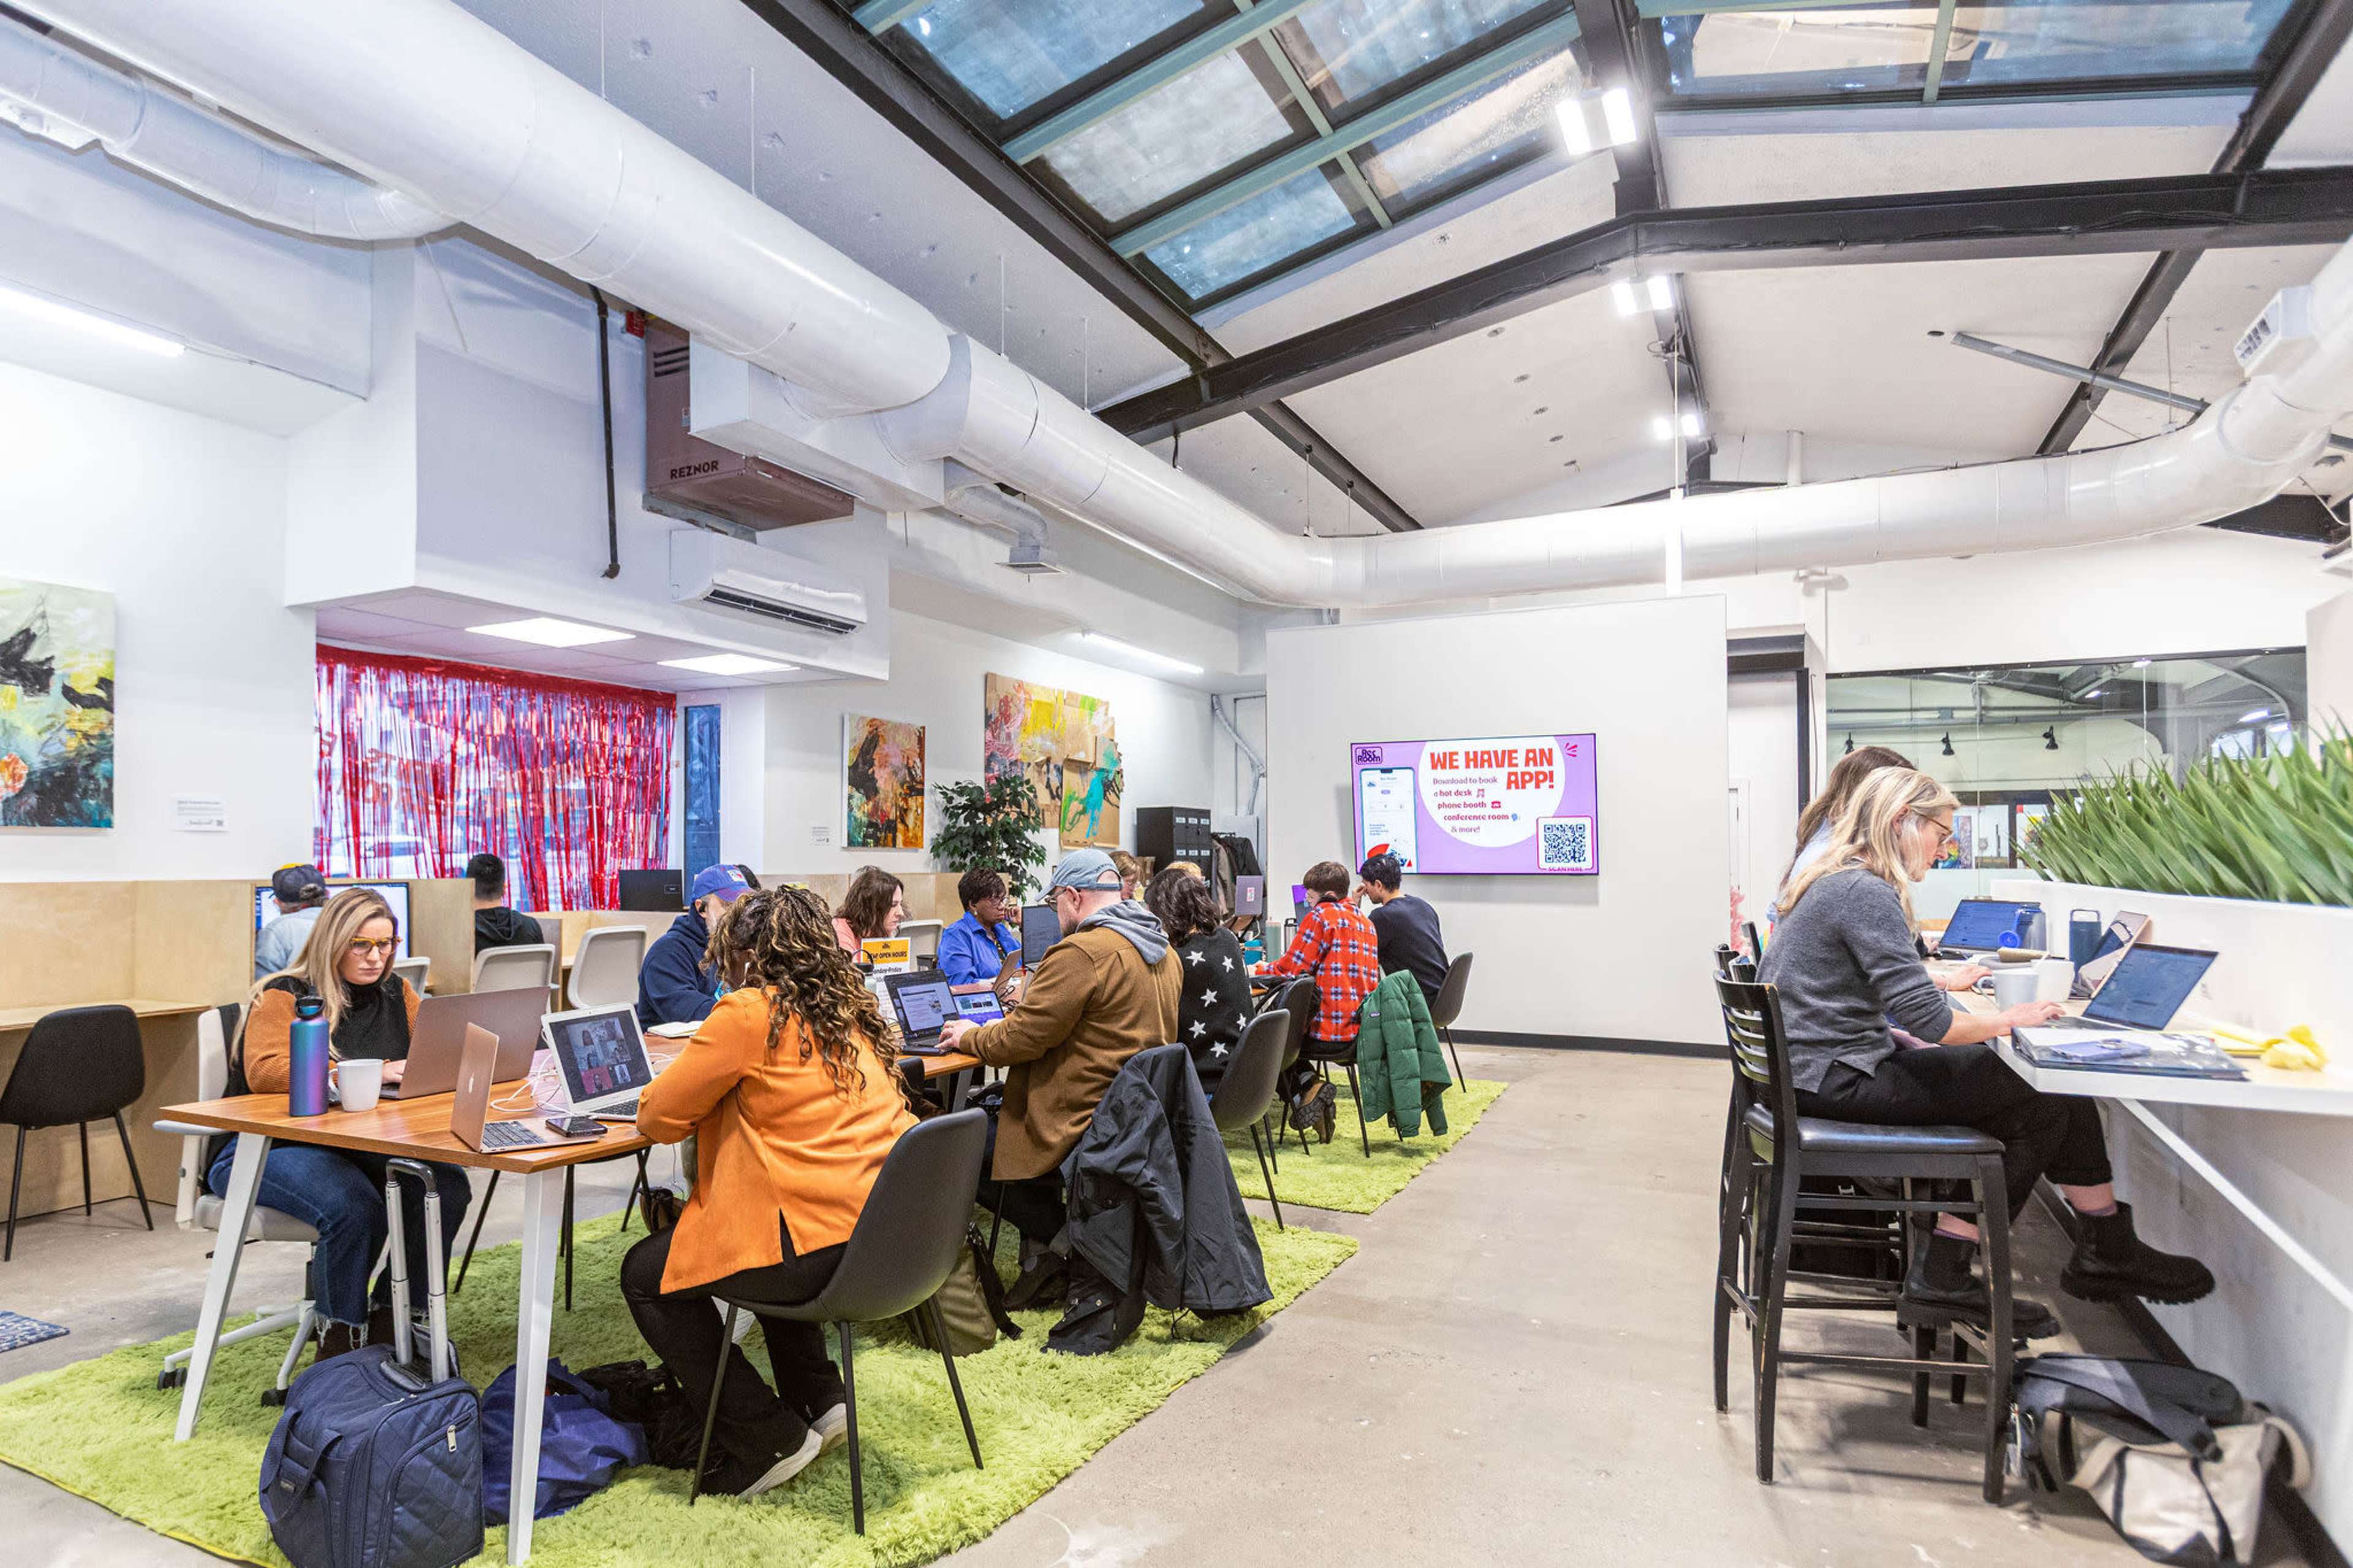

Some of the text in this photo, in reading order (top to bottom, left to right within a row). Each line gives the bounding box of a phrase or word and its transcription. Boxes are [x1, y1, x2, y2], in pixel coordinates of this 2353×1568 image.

[670, 460, 719, 480] REZNOR
[1430, 748, 1553, 770] WE HAVE AN
[1506, 770, 1554, 790] APP!
[1438, 801, 1462, 810] phone
